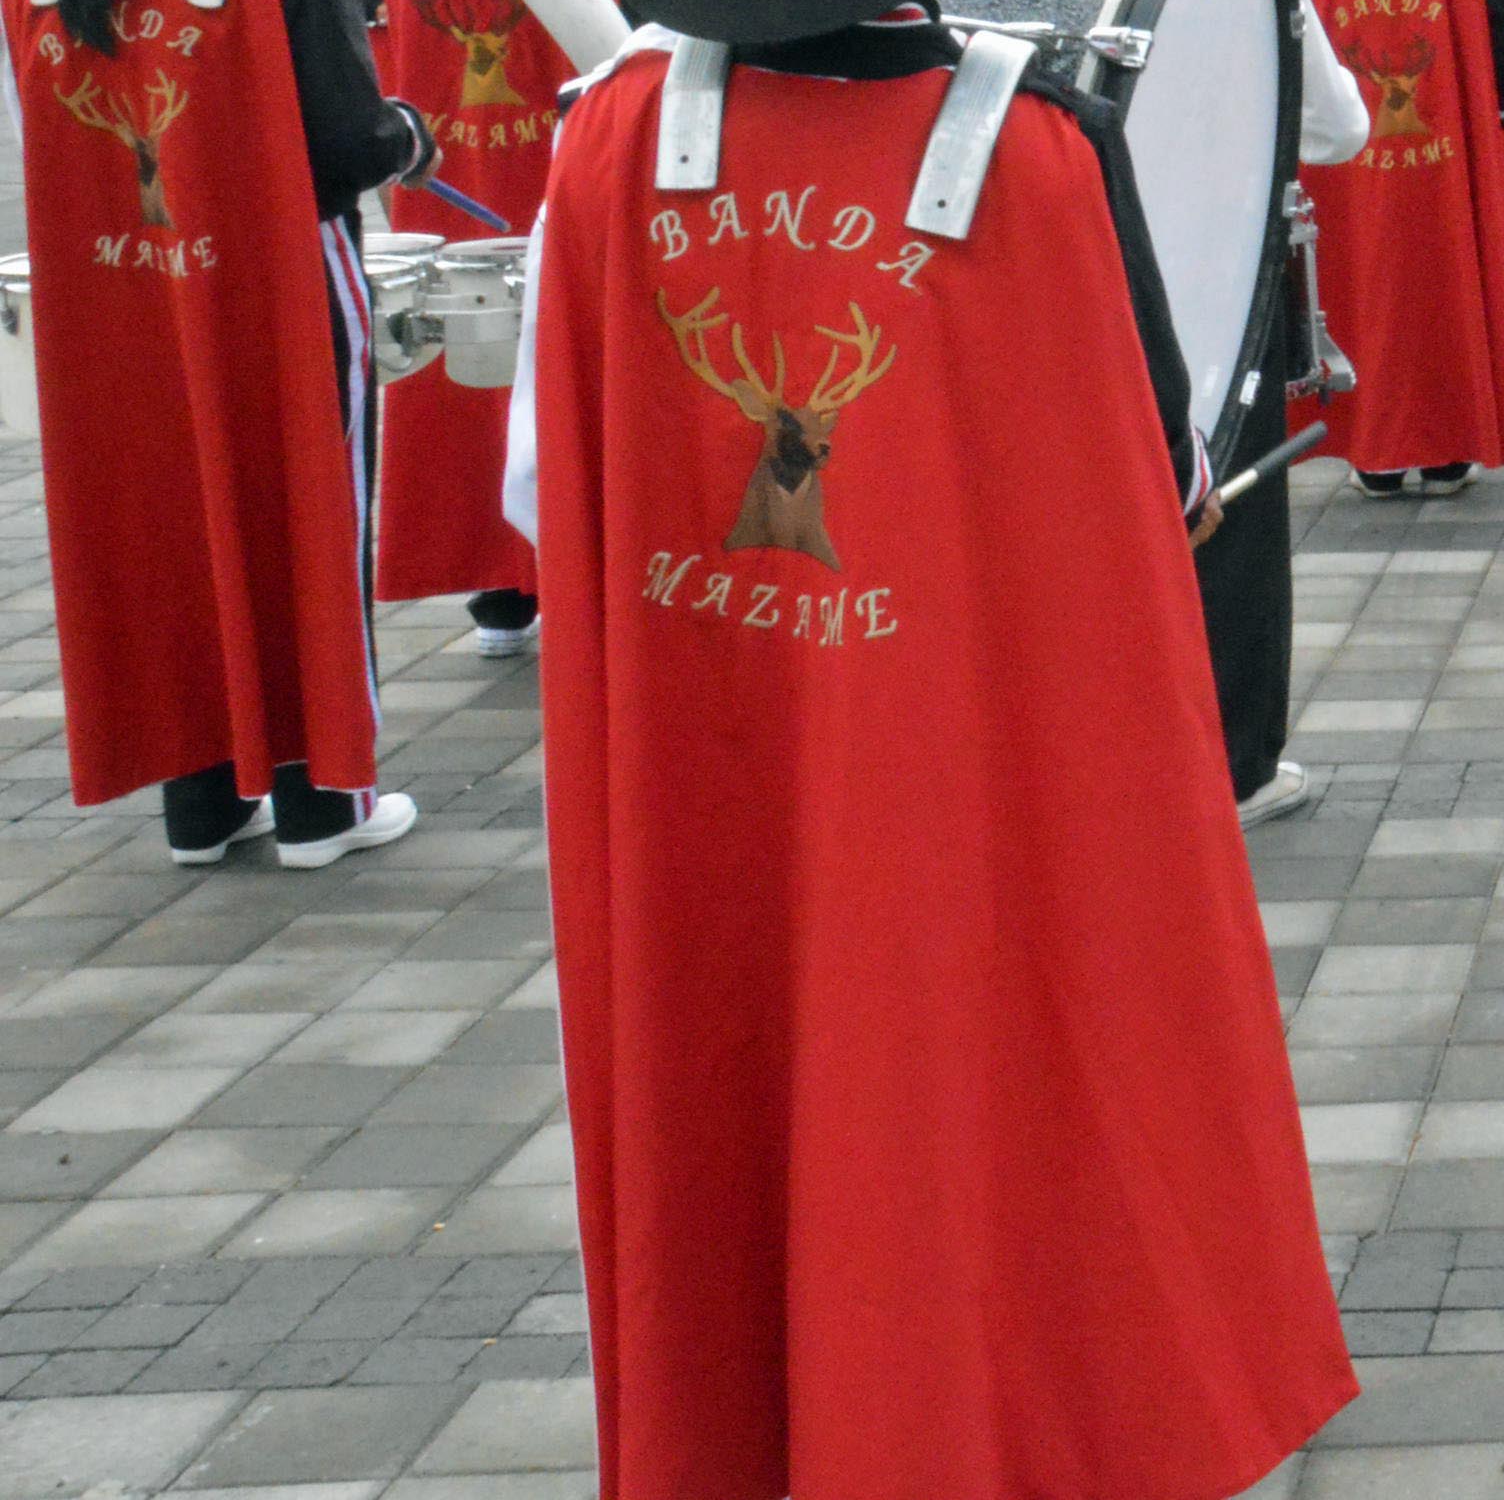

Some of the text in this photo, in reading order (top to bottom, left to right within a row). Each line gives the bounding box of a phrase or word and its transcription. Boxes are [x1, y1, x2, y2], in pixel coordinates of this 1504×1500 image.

[1359, 137, 1454, 168] AZAME
[650, 185, 935, 290] BANDA
[642, 550, 898, 647] MAZAME
